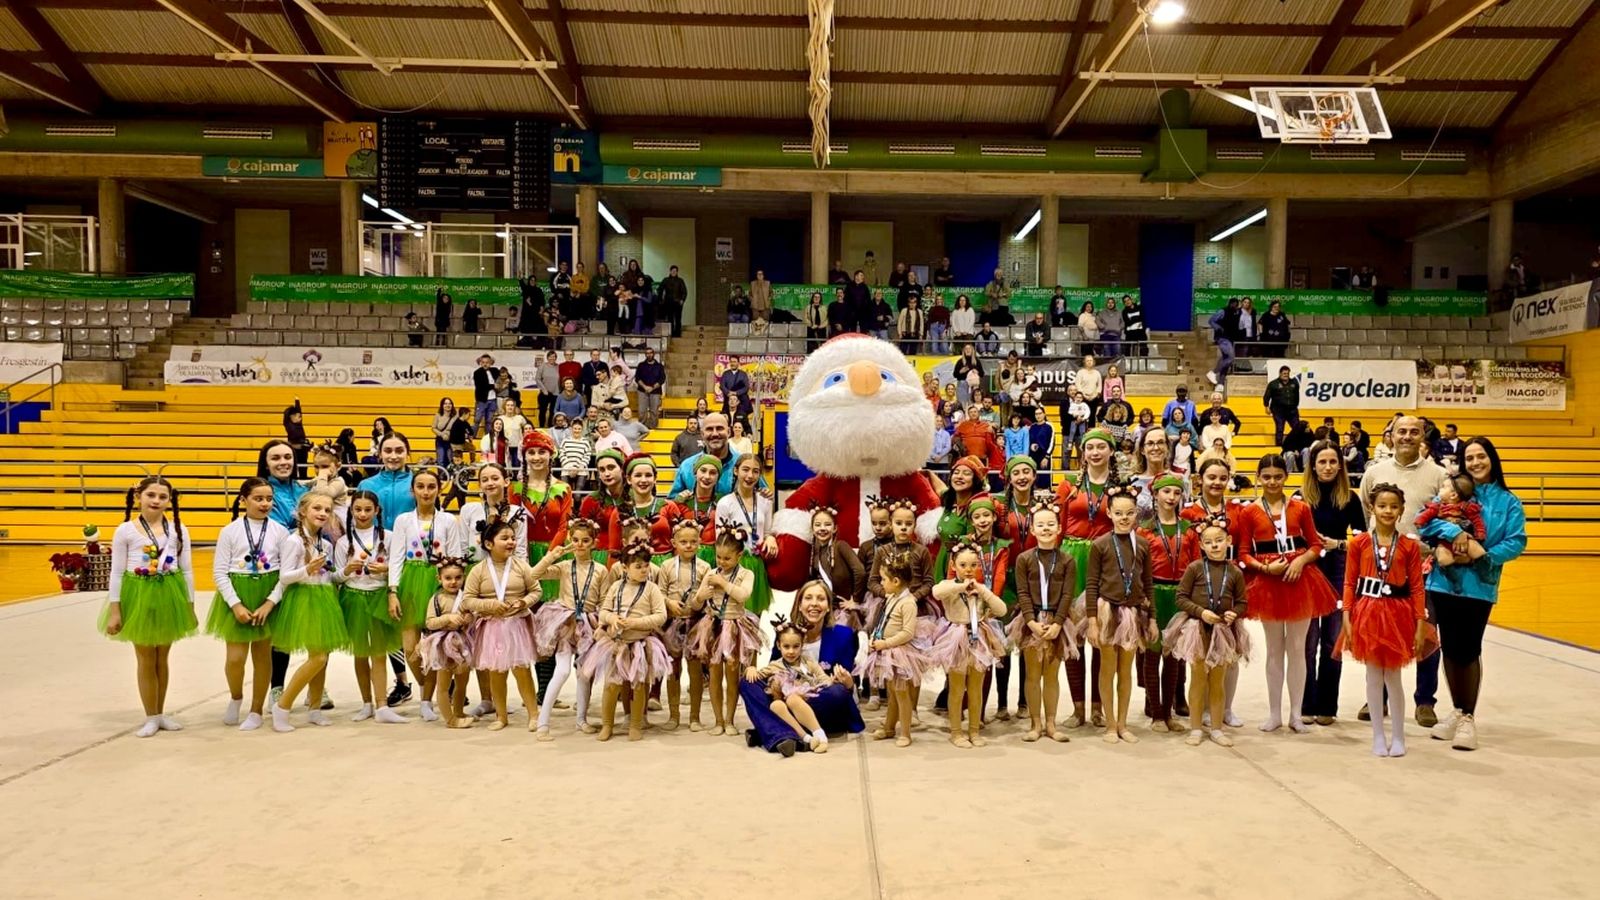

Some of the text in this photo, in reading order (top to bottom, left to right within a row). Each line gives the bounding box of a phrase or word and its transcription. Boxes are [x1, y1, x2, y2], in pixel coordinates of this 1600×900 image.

[425, 137, 449, 145] LOCAL
[481, 138, 505, 146] VISITANTE
[243, 160, 299, 174] cajamar
[643, 167, 696, 183] cajamar
[330, 282, 368, 290] INAGROUP
[372, 283, 408, 291] INAGROUP
[1526, 296, 1558, 319] nex
[220, 363, 256, 380] sabor
[393, 365, 430, 382] sabor
[1305, 378, 1410, 402] agroclean
[1506, 388, 1559, 397] INAGROUP
